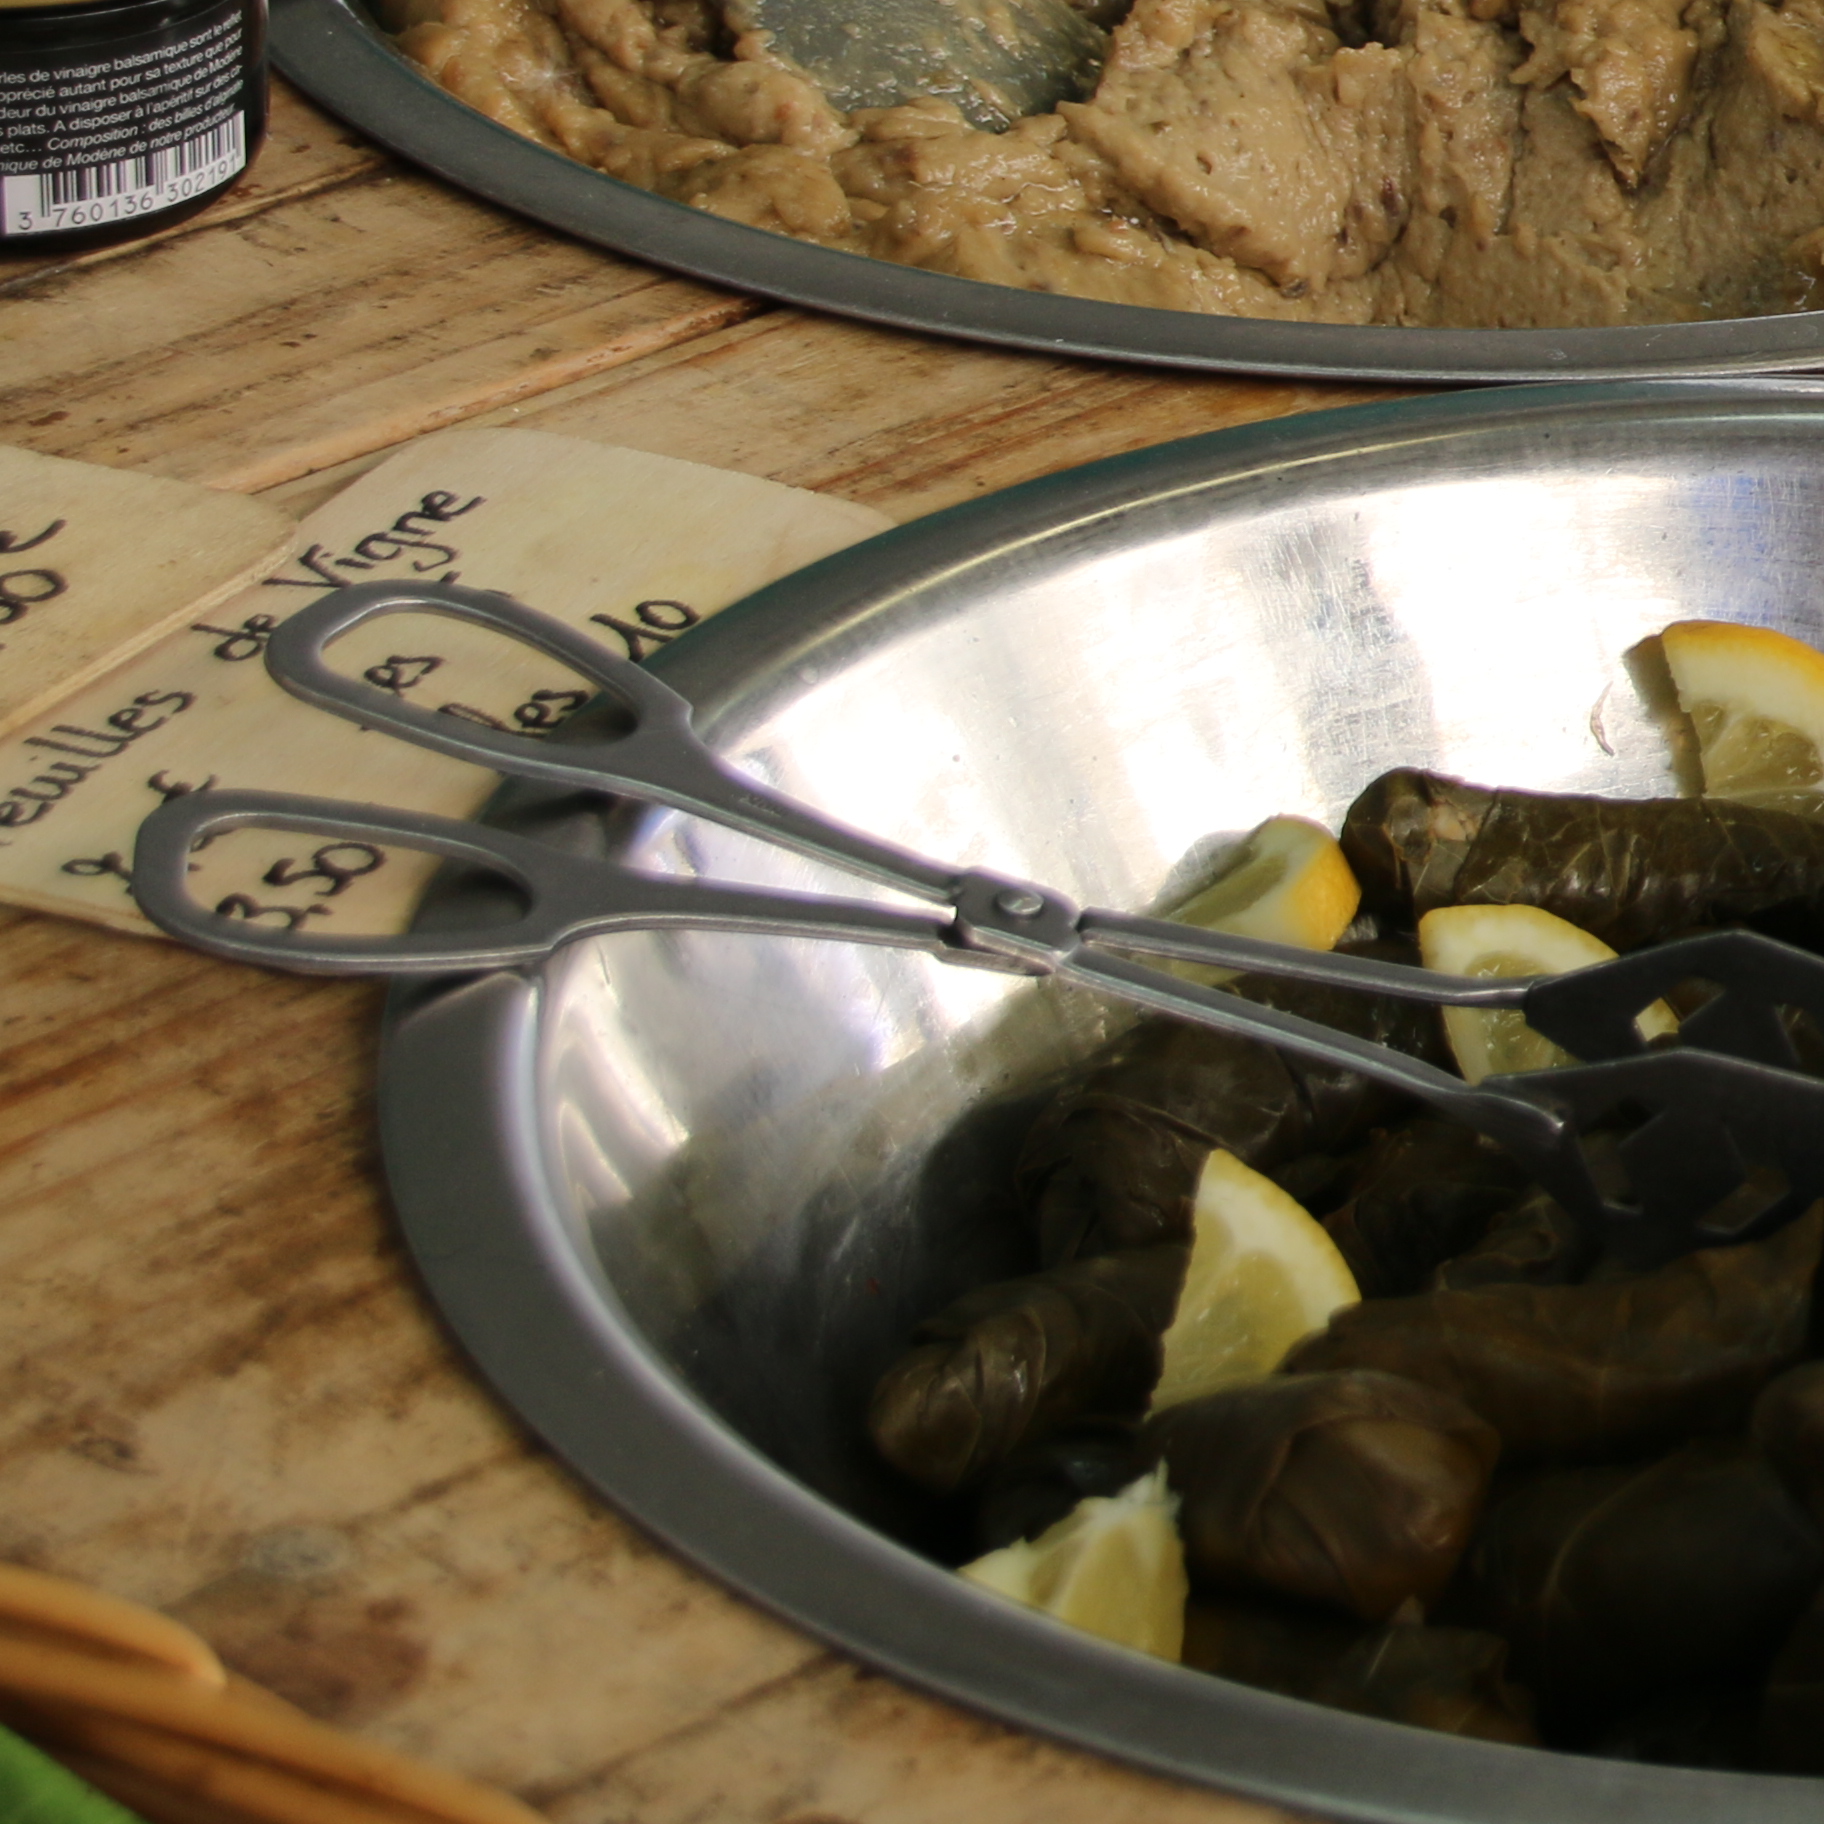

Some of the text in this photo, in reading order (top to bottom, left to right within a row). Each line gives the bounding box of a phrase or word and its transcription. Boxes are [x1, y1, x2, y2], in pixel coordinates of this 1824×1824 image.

[29, 69, 51, 83] de
[52, 62, 112, 80] vinaigre
[113, 42, 188, 71] balsamique
[189, 28, 213, 49] sont
[59, 79, 107, 98] autant
[110, 73, 143, 92] pour
[145, 67, 161, 81] sa
[164, 52, 204, 76] texture
[205, 41, 224, 60] que
[7, 122, 50, 139] plats.
[53, 119, 67, 133] A
[69, 108, 132, 131] disposer
[134, 105, 145, 118] à
[194, 80, 212, 98] sur
[35, 104, 56, 117] du
[59, 97, 117, 114] vinaigre
[119, 74, 192, 105] balsamique
[193, 67, 209, 82] de
[42, 156, 63, 170] de
[66, 145, 126, 167] Modène
[129, 140, 148, 155] de
[47, 124, 138, 152] Composition
[148, 116, 172, 133] des
[18, 210, 34, 232] 3
[52, 193, 155, 229] 760136
[0, 686, 196, 844] euilles
[262, 489, 488, 588] Vigne
